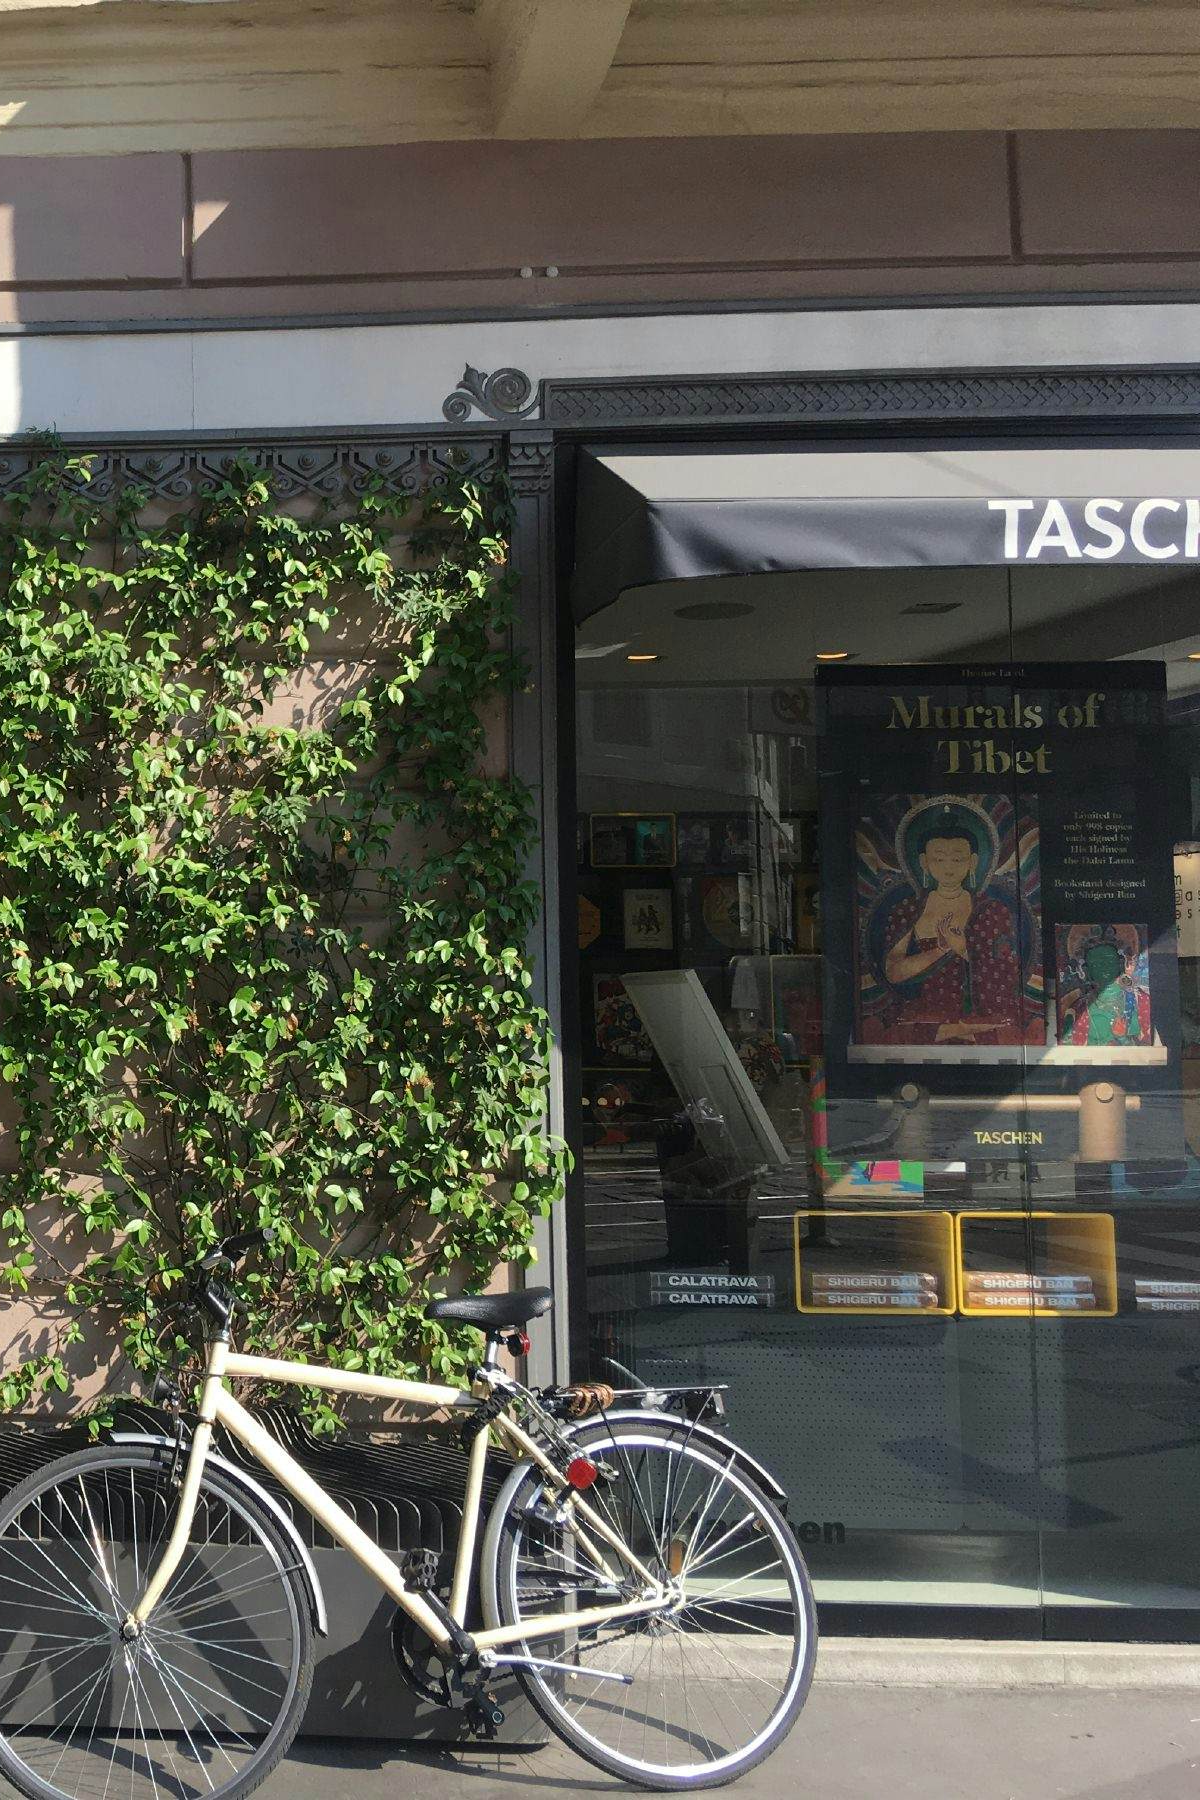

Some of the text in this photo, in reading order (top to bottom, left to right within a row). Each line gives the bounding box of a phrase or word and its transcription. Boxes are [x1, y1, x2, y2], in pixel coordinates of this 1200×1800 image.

[987, 498, 1200, 560] TASC
[886, 692, 1106, 729] Murals of
[937, 739, 1054, 775] Tibet
[1074, 811, 1122, 820] Limited to
[1105, 823, 1133, 833] copies
[1088, 833, 1118, 844] signed
[1120, 833, 1131, 844] by
[1071, 845, 1128, 854] His Holiness
[1063, 856, 1081, 865] the
[1108, 856, 1135, 865] Lama
[1054, 879, 1146, 890] Bookstand designed
[1064, 890, 1136, 901] by Shigeru Ban
[973, 1131, 1043, 1145] TASCHEN
[668, 1275, 758, 1287] CALATRAVA
[828, 1277, 919, 1287] SHIGERU BAN
[983, 1279, 1074, 1289] SHIGERU BAN
[668, 1293, 758, 1305] CALATRAVA
[828, 1295, 919, 1305] SHIGERU BAN
[984, 1297, 1077, 1306] SHIGERU BAN
